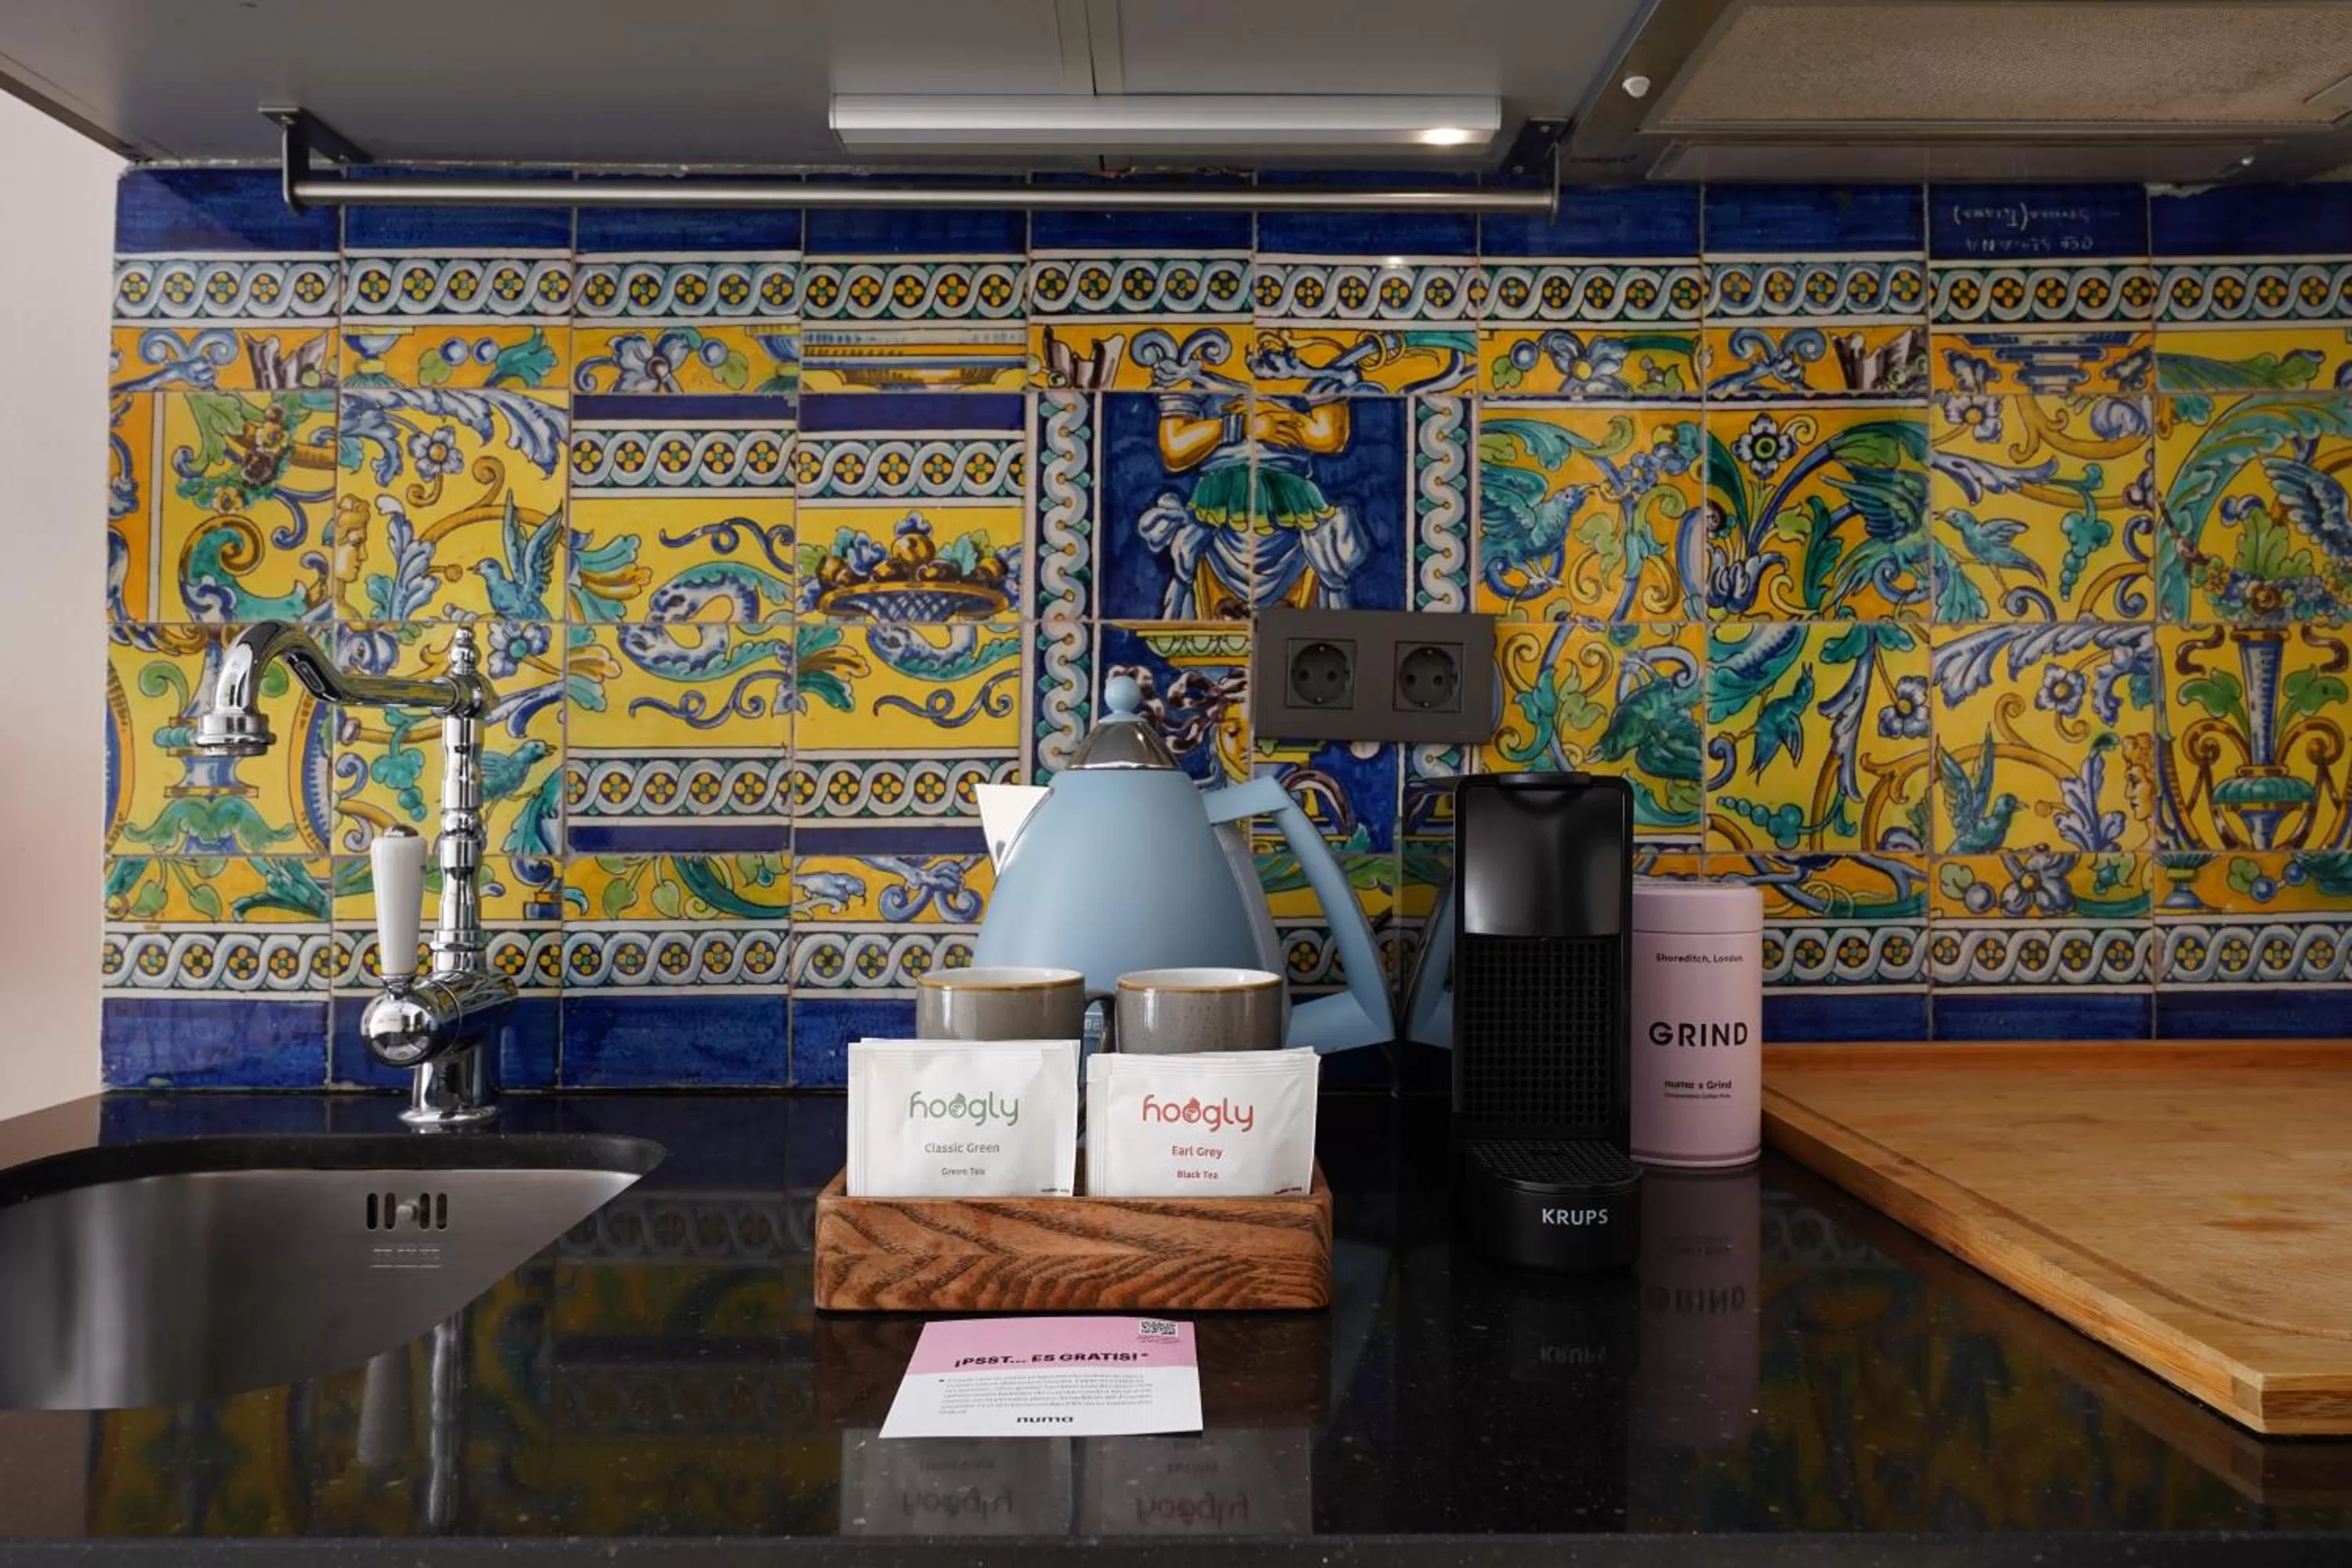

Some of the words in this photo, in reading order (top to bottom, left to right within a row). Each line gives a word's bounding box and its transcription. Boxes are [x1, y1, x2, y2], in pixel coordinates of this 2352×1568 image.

[1655, 953, 1711, 964] Shoreditch,
[1649, 1022, 1748, 1047] GRIND
[1707, 1080, 1732, 1089] Grind
[909, 1091, 1018, 1127] hoogly
[1142, 1094, 1254, 1133] hoogly
[924, 1142, 964, 1154] Classic
[966, 1142, 1000, 1154] Green
[1171, 1145, 1194, 1157] Earl
[1196, 1147, 1223, 1160] Grey
[941, 1167, 968, 1176] Green
[1177, 1169, 1201, 1179] Black
[1203, 1170, 1219, 1180] Tea
[1542, 1208, 1609, 1225] KRUPS
